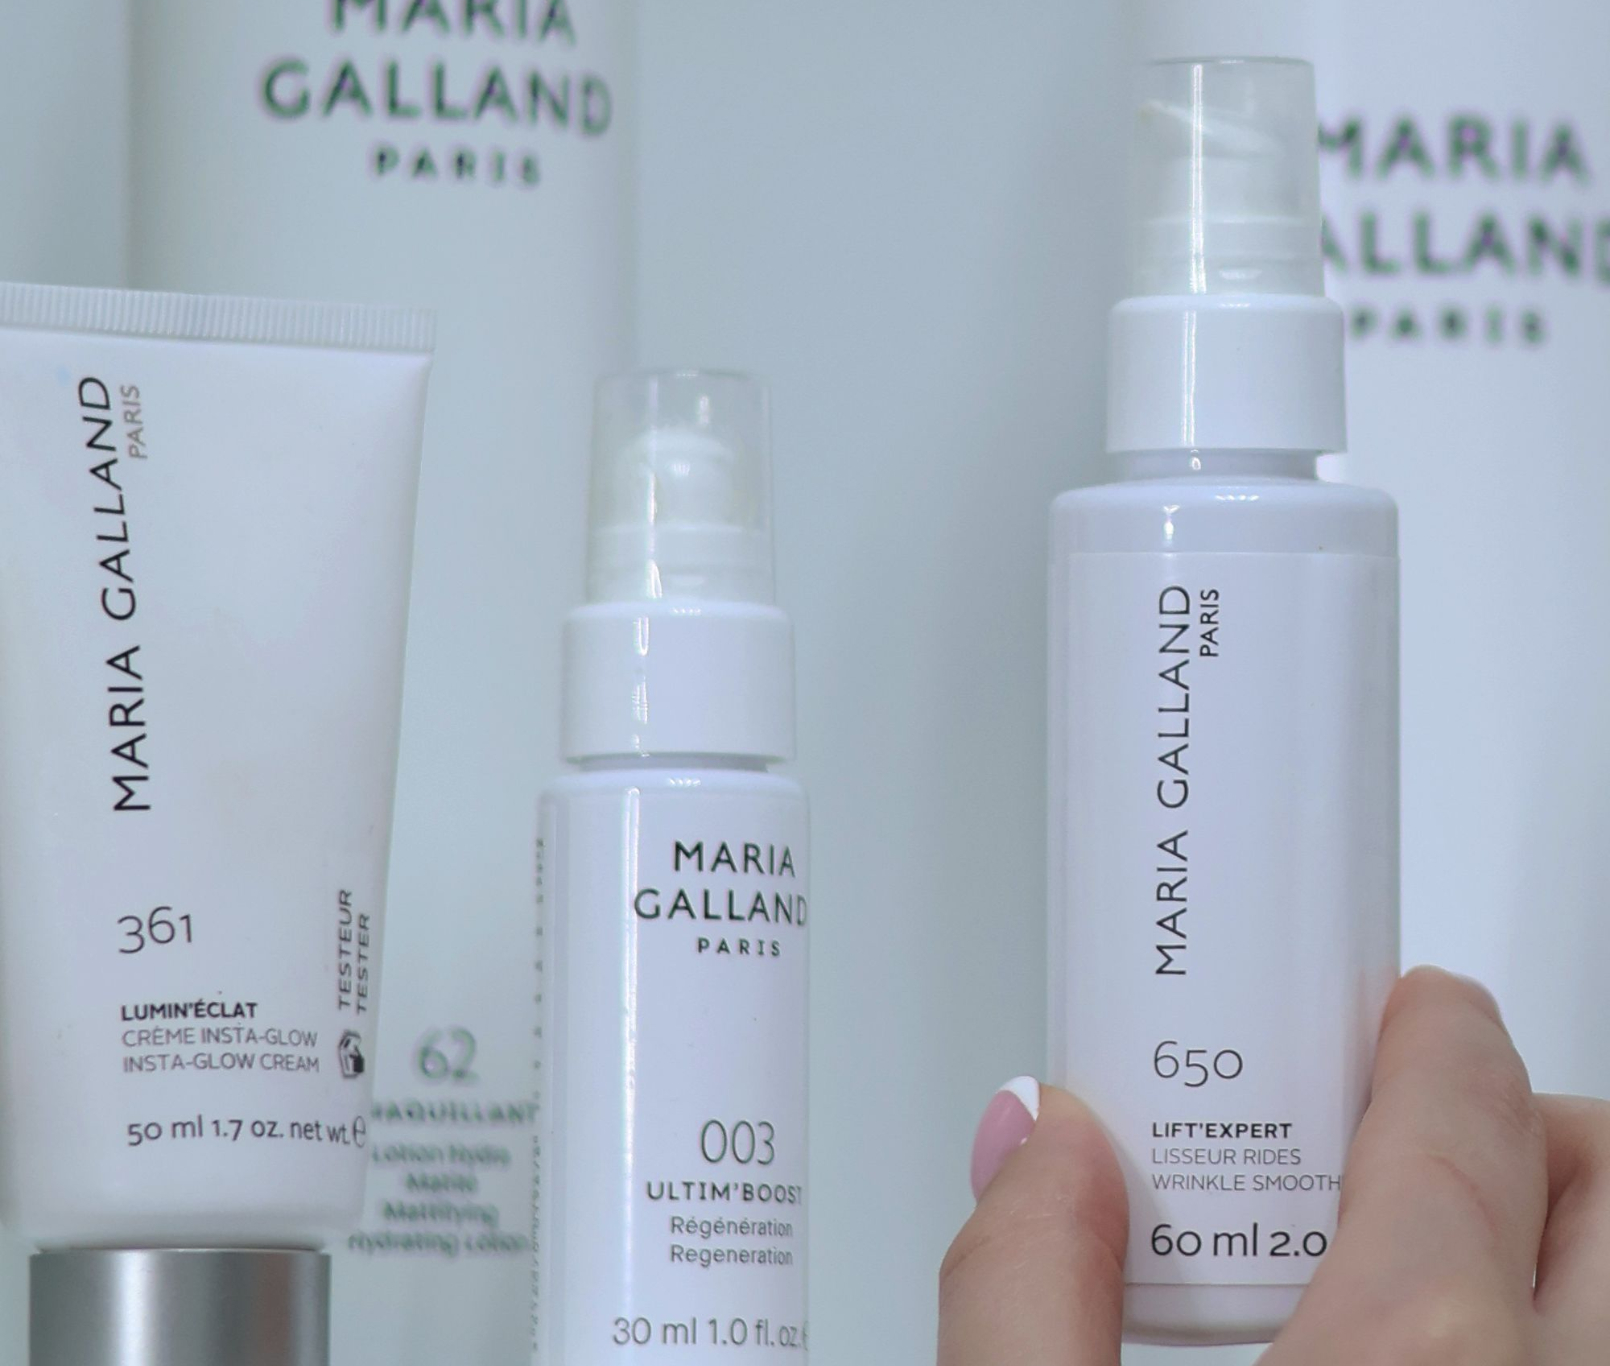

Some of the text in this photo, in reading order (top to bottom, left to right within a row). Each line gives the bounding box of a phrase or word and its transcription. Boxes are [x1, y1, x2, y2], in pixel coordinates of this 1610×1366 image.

[262, 56, 612, 136] GALLAND
[375, 144, 541, 186] PARIS
[120, 384, 148, 460] PARIS
[79, 376, 151, 811] MARIA GALLAND
[1199, 588, 1220, 657] PARIS
[1155, 585, 1191, 975] MARIA GALLAND
[674, 840, 796, 878] MARIA
[634, 888, 808, 926] GALLAND
[117, 906, 193, 954] 361
[697, 937, 781, 957] PARIS
[338, 889, 352, 1011] TESTEUR
[356, 913, 370, 1016] TESTER
[121, 998, 258, 1021] LUMIN'ÉCLAT
[201, 1027, 318, 1047] INSTA-GLOW
[418, 1027, 480, 1080] 62
[123, 1053, 320, 1073] INSTA-GLOW CREAM
[1154, 1040, 1243, 1087] 650
[128, 1122, 163, 1146] 50
[172, 1114, 203, 1139] ml
[212, 1119, 243, 1142] 1.7
[251, 1121, 284, 1139] oz.
[291, 1120, 323, 1142] net
[701, 1119, 775, 1165] 003
[1152, 1122, 1292, 1138] LIFT'EXPERT
[1152, 1148, 1302, 1165] LISSEUR RIDES
[1152, 1174, 1246, 1191] WRINKLE
[671, 1215, 794, 1239] Régénération
[1151, 1222, 1328, 1257] 60 ml 2.0
[671, 1244, 794, 1267] Regeneration
[613, 1317, 651, 1346] 30
[662, 1317, 697, 1345] ml
[708, 1317, 748, 1346] 1.0
